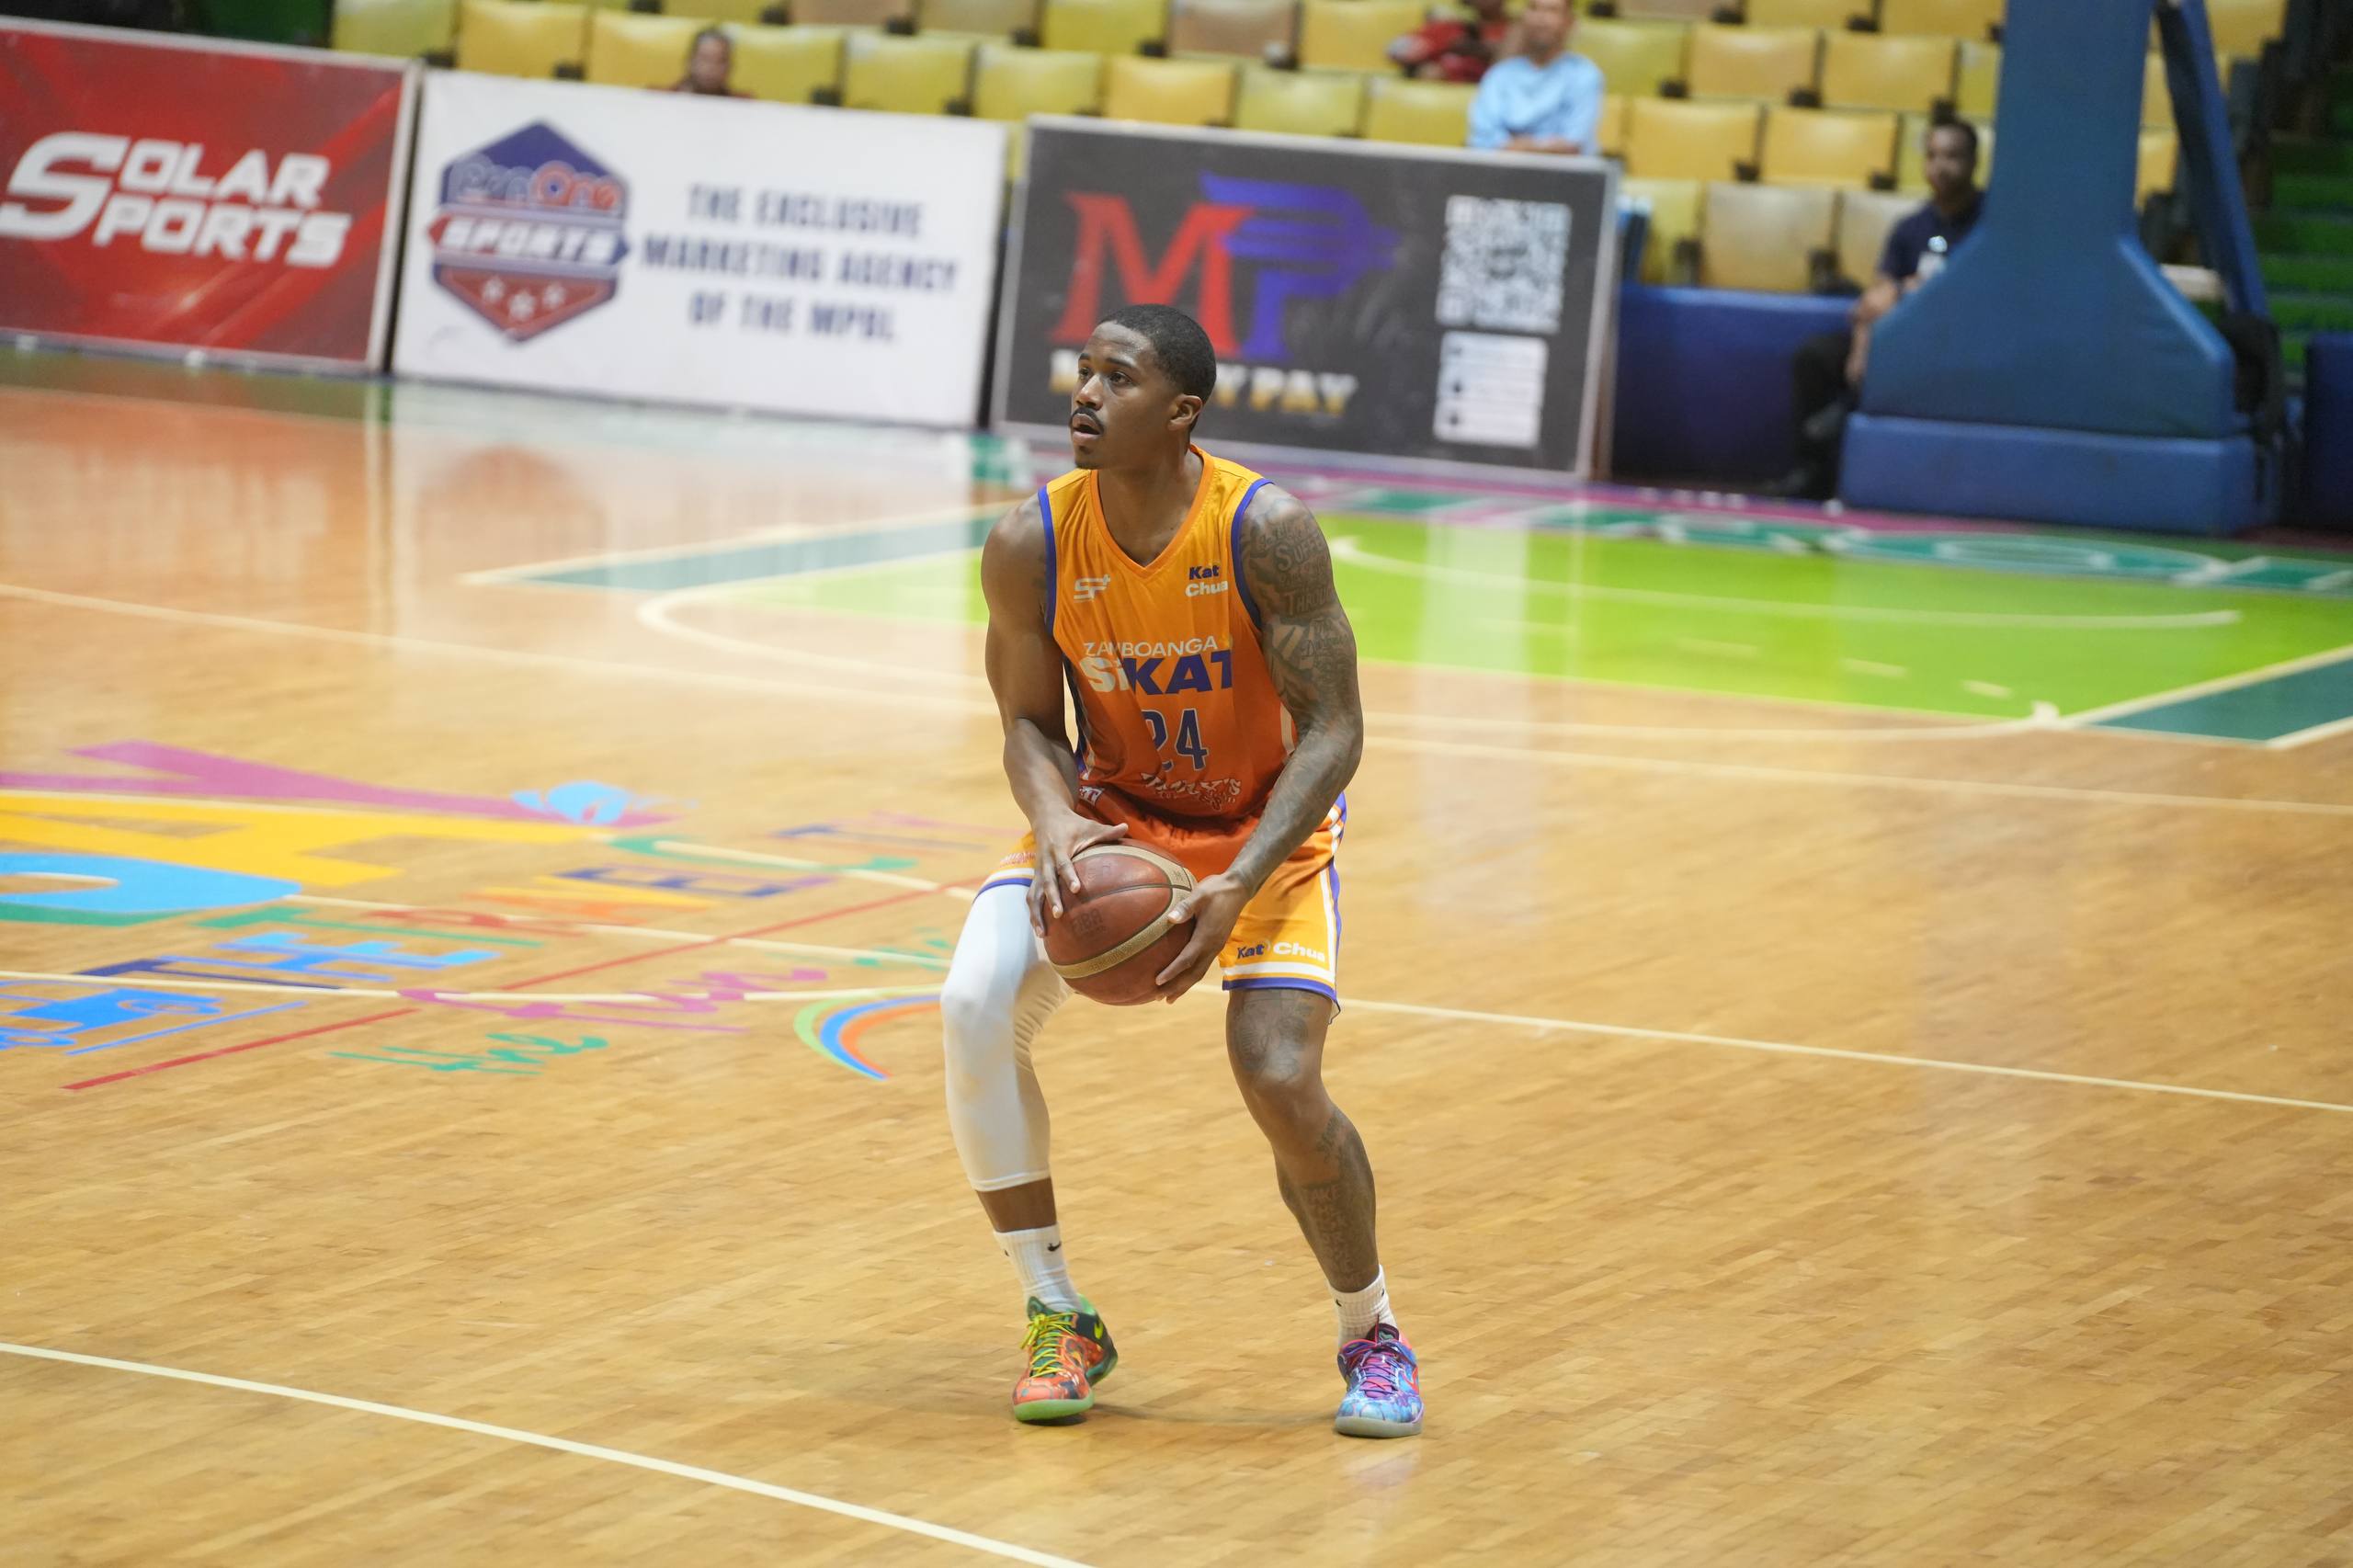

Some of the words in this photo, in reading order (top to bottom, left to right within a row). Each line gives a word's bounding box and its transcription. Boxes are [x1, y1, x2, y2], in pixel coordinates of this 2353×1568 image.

[689, 183, 739, 222] THE
[756, 189, 922, 236] EXCLUSIVE
[438, 215, 619, 266] SPORTS
[642, 233, 822, 278] MARKETING
[837, 250, 958, 290] AGENCY
[689, 290, 725, 324] OF
[740, 294, 792, 329] THE
[1185, 581, 1229, 597] Chua
[1188, 564, 1220, 580] Kat
[1237, 943, 1265, 959] Kat
[1273, 942, 1325, 962] Chua
